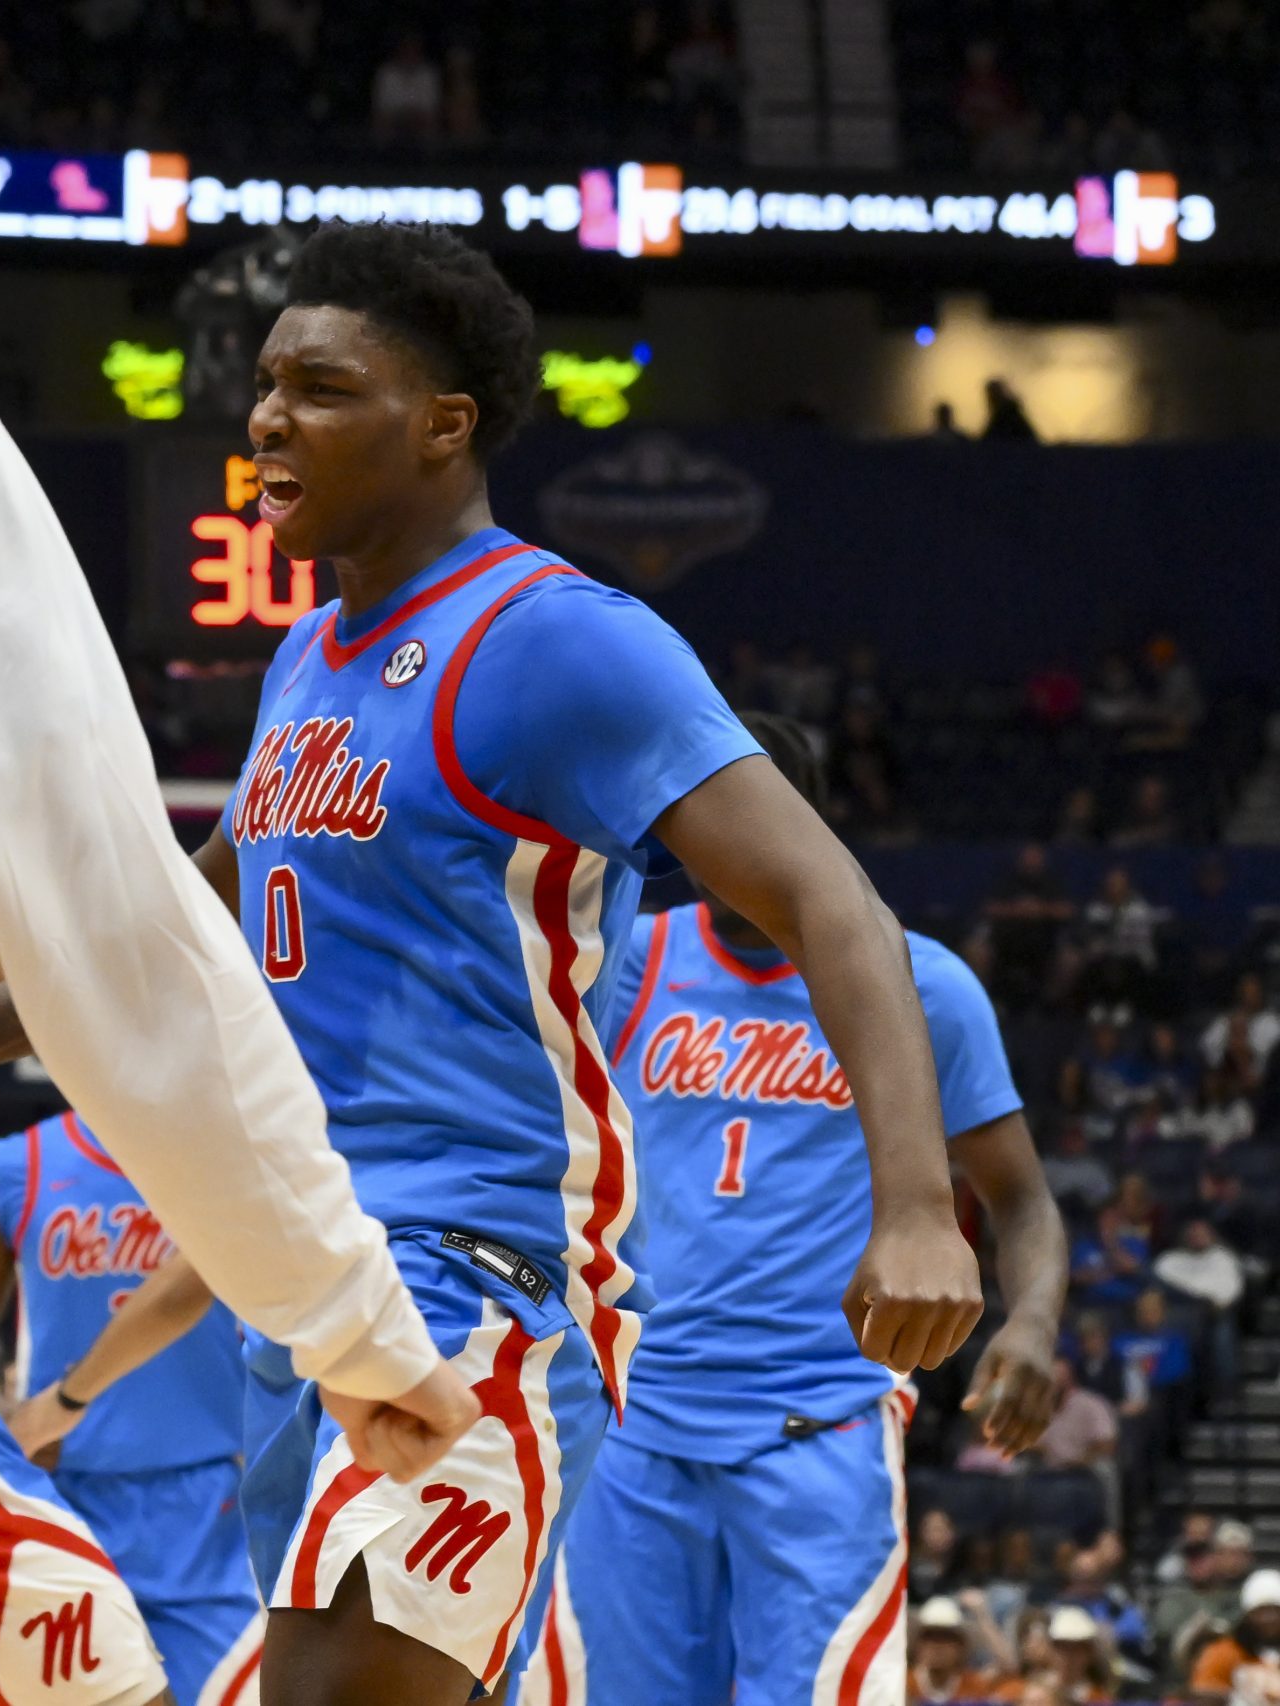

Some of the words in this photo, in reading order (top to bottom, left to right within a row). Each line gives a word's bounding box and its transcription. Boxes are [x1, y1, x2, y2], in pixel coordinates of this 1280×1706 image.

[191, 515, 316, 627] 30
[384, 641, 424, 684] SEC
[232, 723, 295, 848] Ole
[273, 716, 391, 842] Miss
[262, 864, 306, 983] 0
[641, 1011, 726, 1098] Ole
[714, 1117, 751, 1197] 1
[39, 1203, 108, 1280] Ole
[520, 1268, 537, 1291] 52
